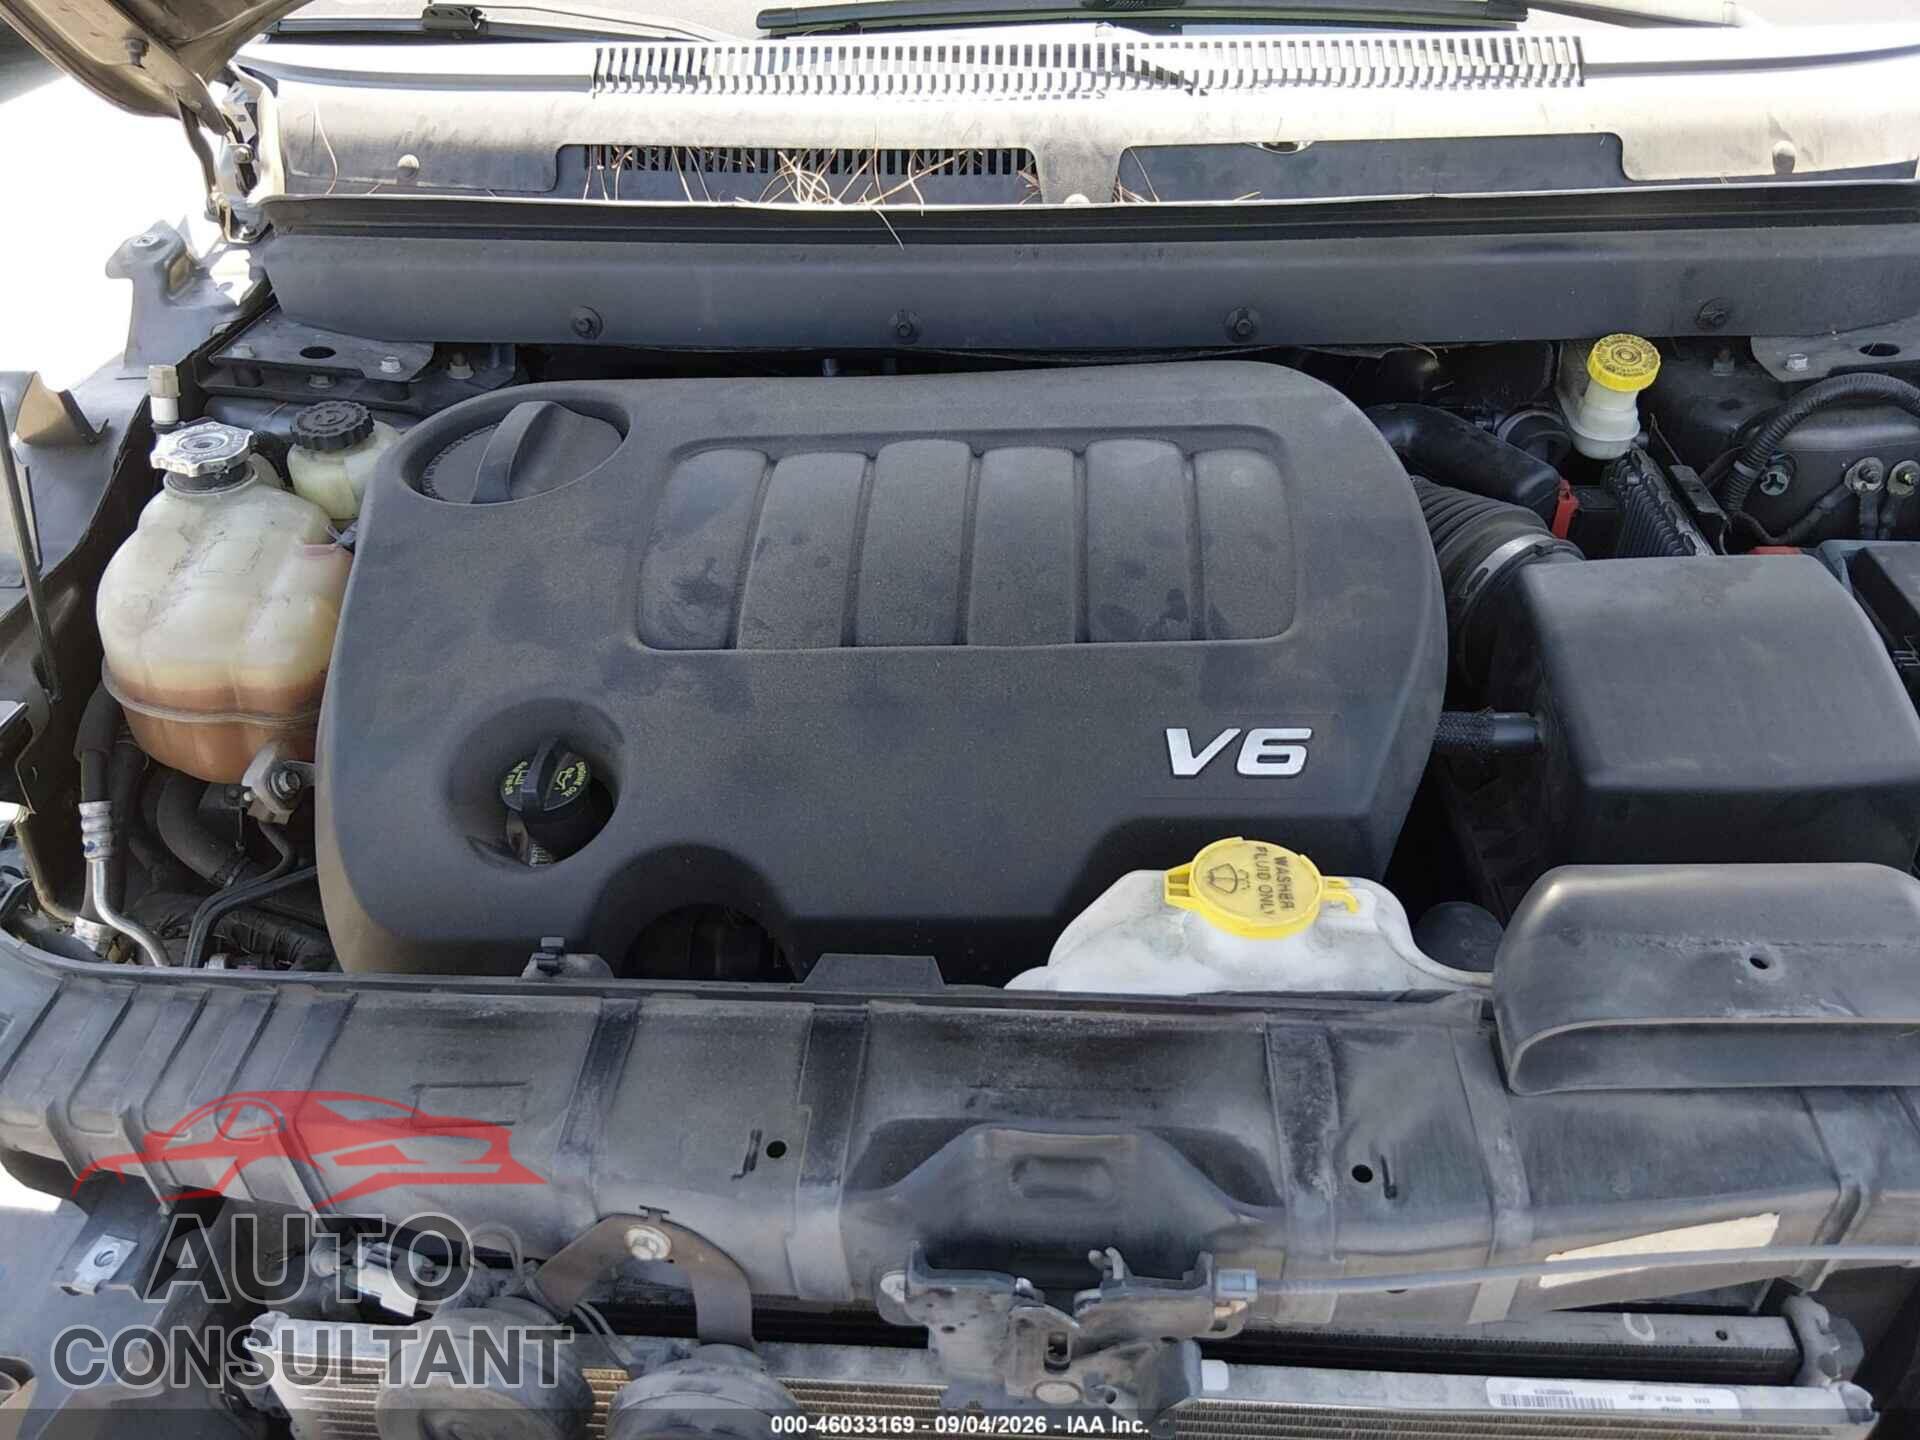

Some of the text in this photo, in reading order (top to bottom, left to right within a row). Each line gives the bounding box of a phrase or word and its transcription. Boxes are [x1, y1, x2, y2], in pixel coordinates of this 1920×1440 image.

[1166, 728, 1313, 775] V6
[1254, 846, 1276, 915] FLUID ONLY
[1274, 856, 1295, 910] WASHER
